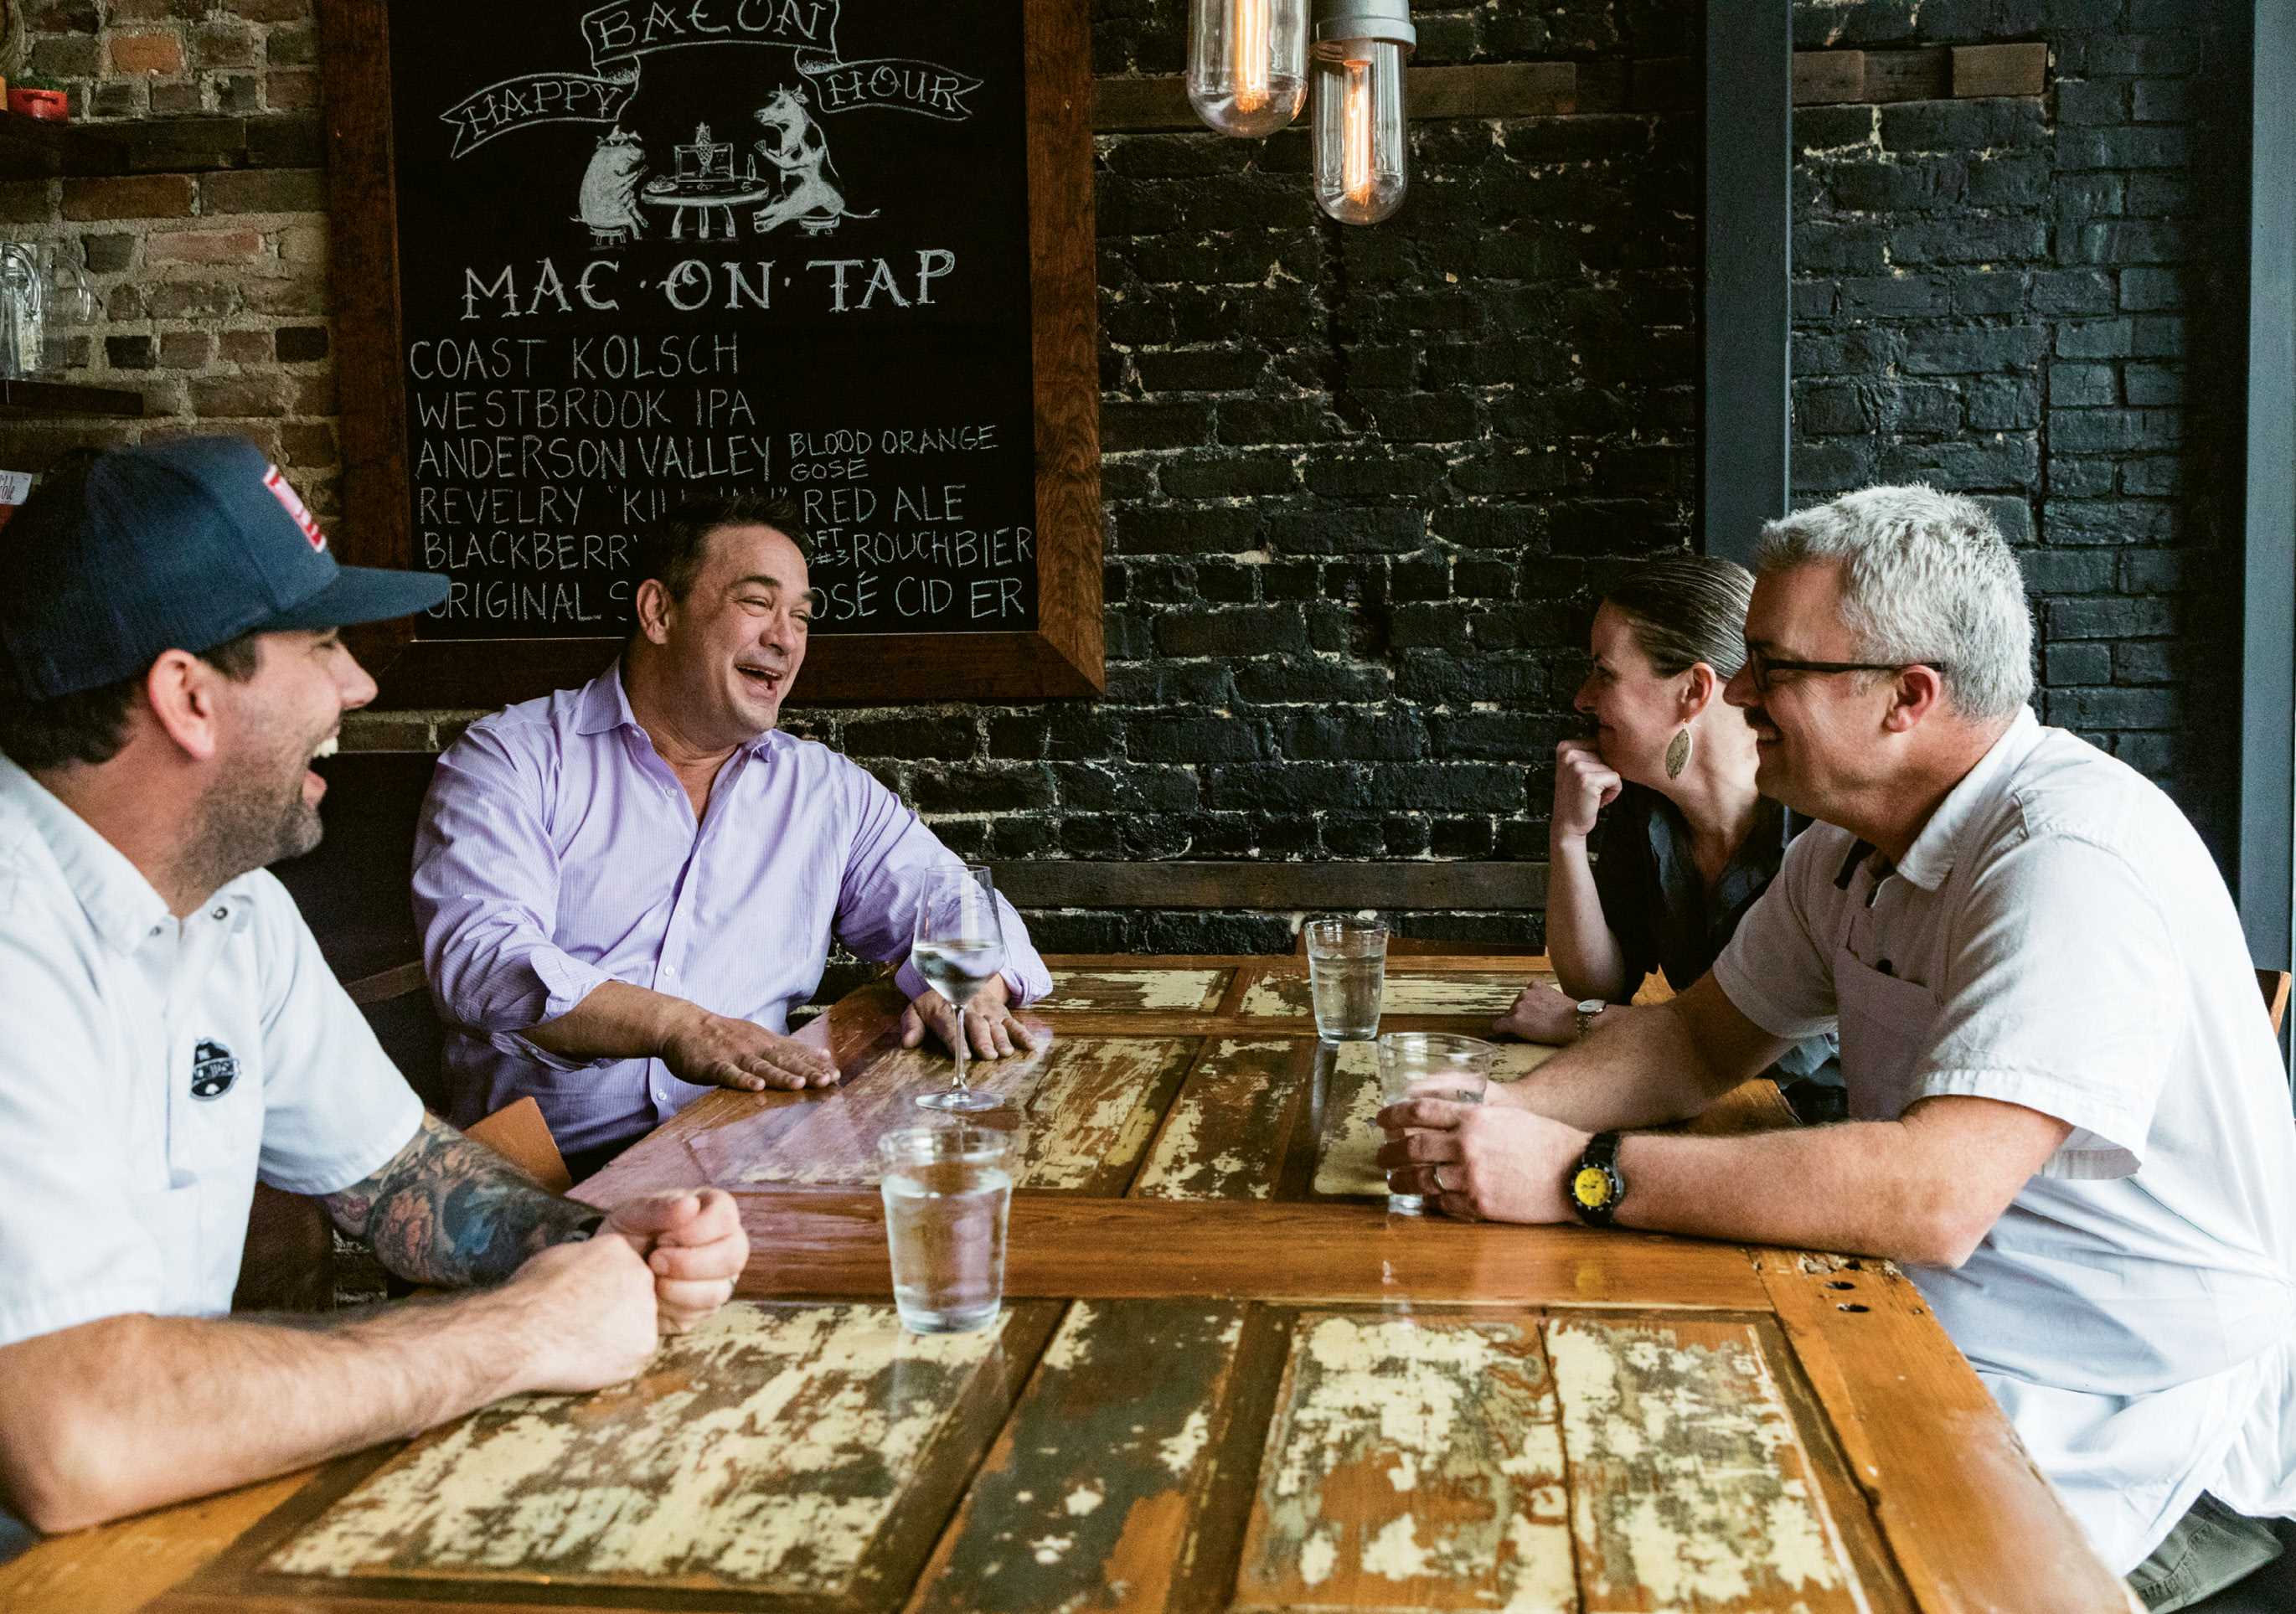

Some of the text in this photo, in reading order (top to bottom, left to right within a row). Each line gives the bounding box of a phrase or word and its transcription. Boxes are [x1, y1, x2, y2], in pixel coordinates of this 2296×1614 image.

[460, 0, 963, 138] HAPPY BACON HOUR
[460, 249, 956, 321] MAC ON TAP
[410, 333, 738, 380] COAST KOLSCH
[417, 387, 756, 430] WESTBROOK IPA
[416, 425, 996, 482] ANDERSON VALLEY BLOOD ORANGE
[790, 458, 869, 482] GOSE
[420, 486, 583, 525] REVELRY
[804, 487, 877, 524] RED
[894, 485, 966, 523] ALE
[424, 530, 637, 570] BLACKBERR
[854, 526, 1032, 568] ROUCHBIER
[809, 570, 881, 621] OSÉ
